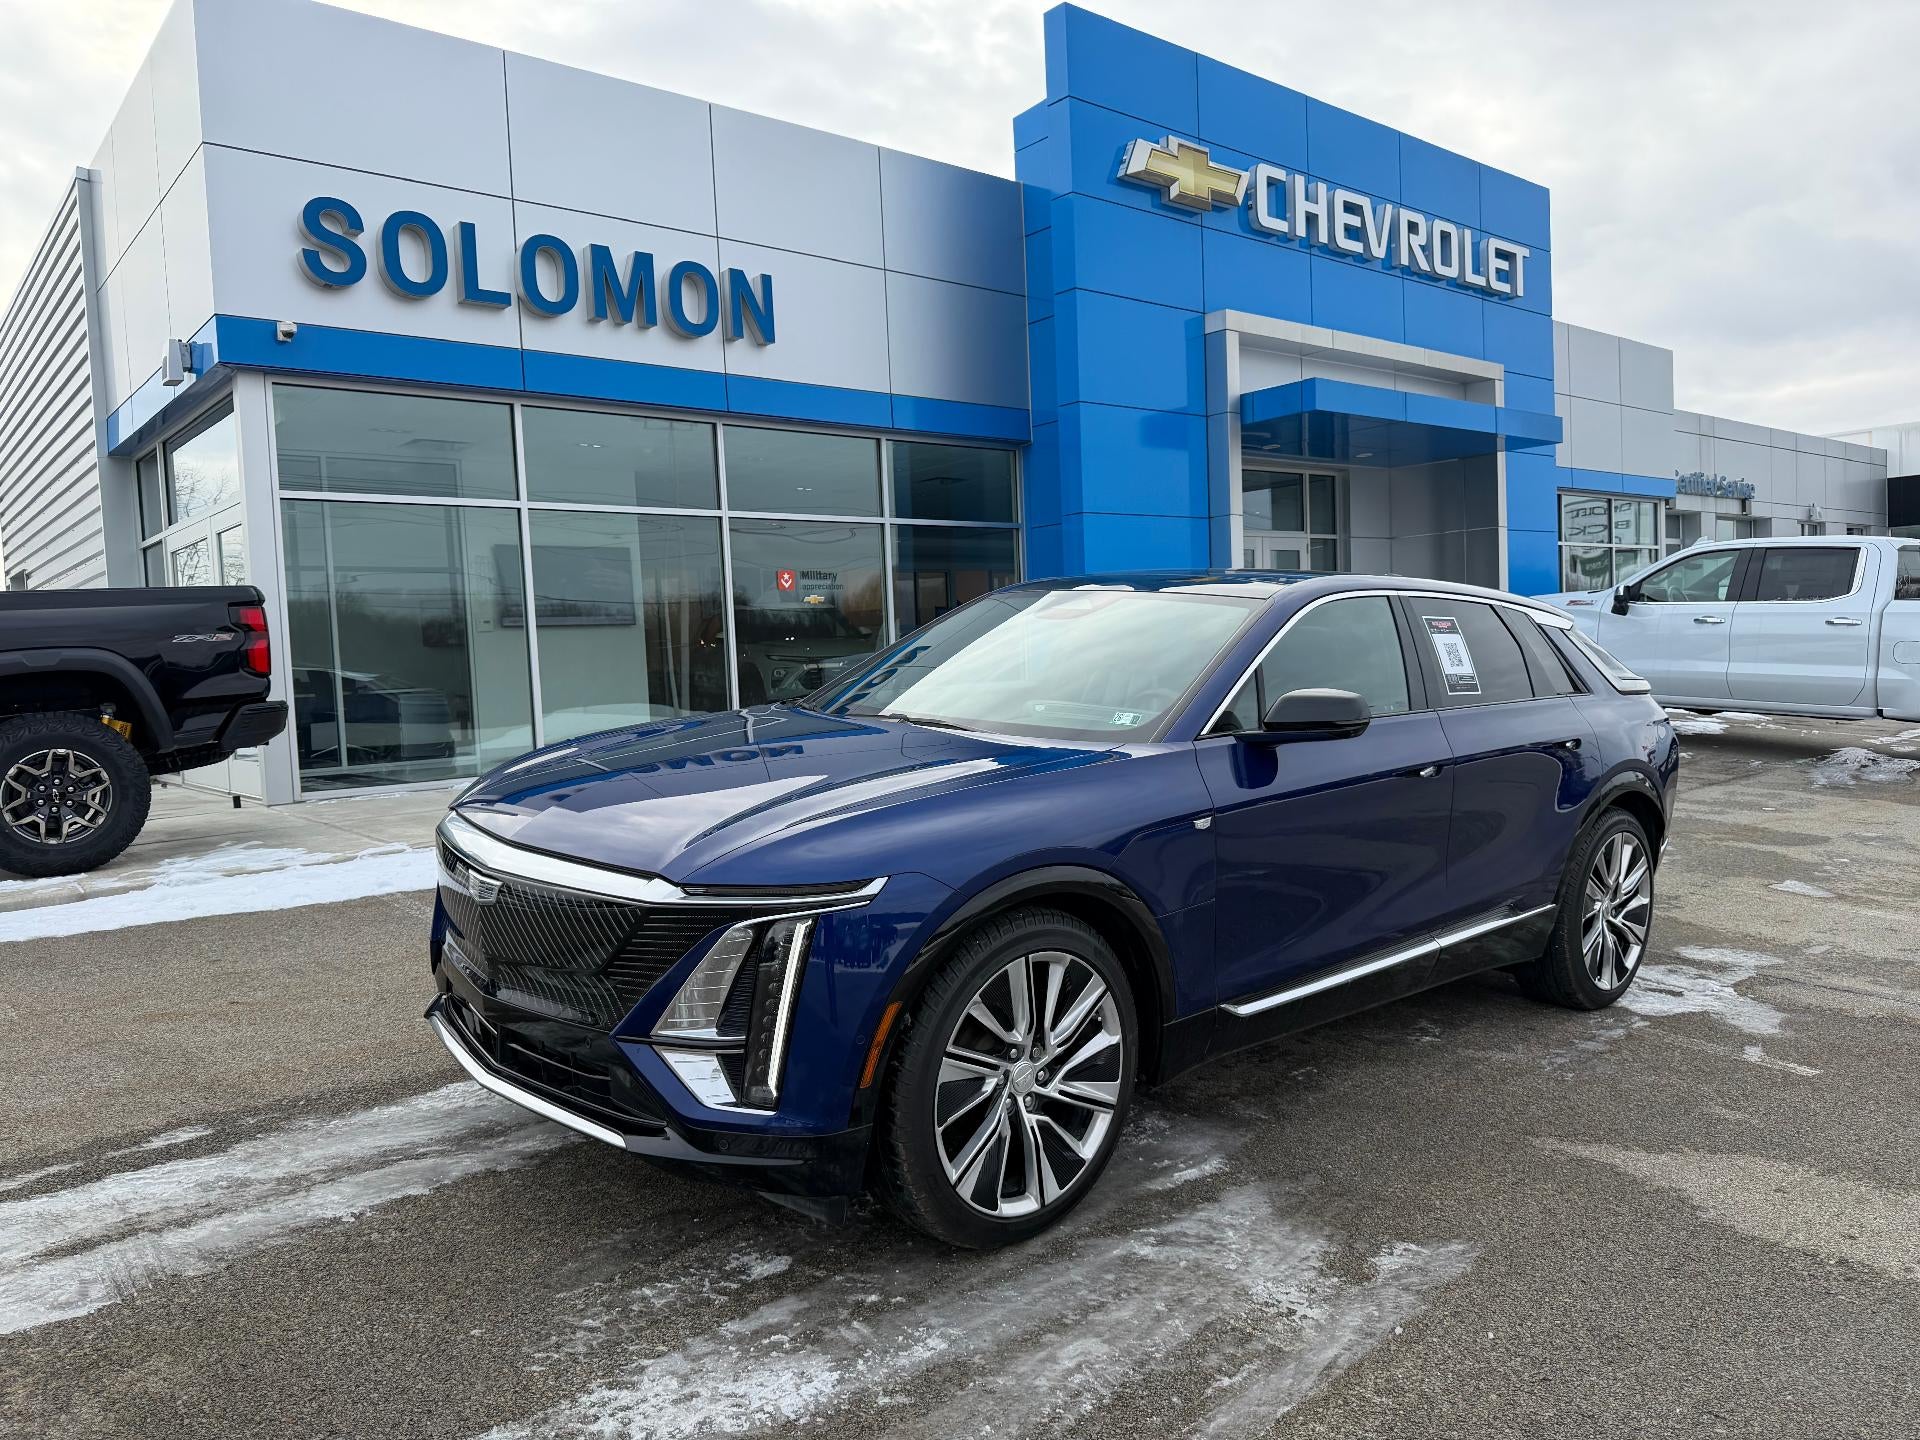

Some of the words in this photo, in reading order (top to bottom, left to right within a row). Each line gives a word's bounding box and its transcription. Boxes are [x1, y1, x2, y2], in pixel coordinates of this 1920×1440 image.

[1248, 163, 1530, 298] CHEVROLET
[297, 196, 776, 346] SOLOMON
[1675, 469, 1717, 496] ertified
[1719, 475, 1756, 499] Service
[801, 570, 838, 582] Military
[802, 583, 844, 591] appreciation
